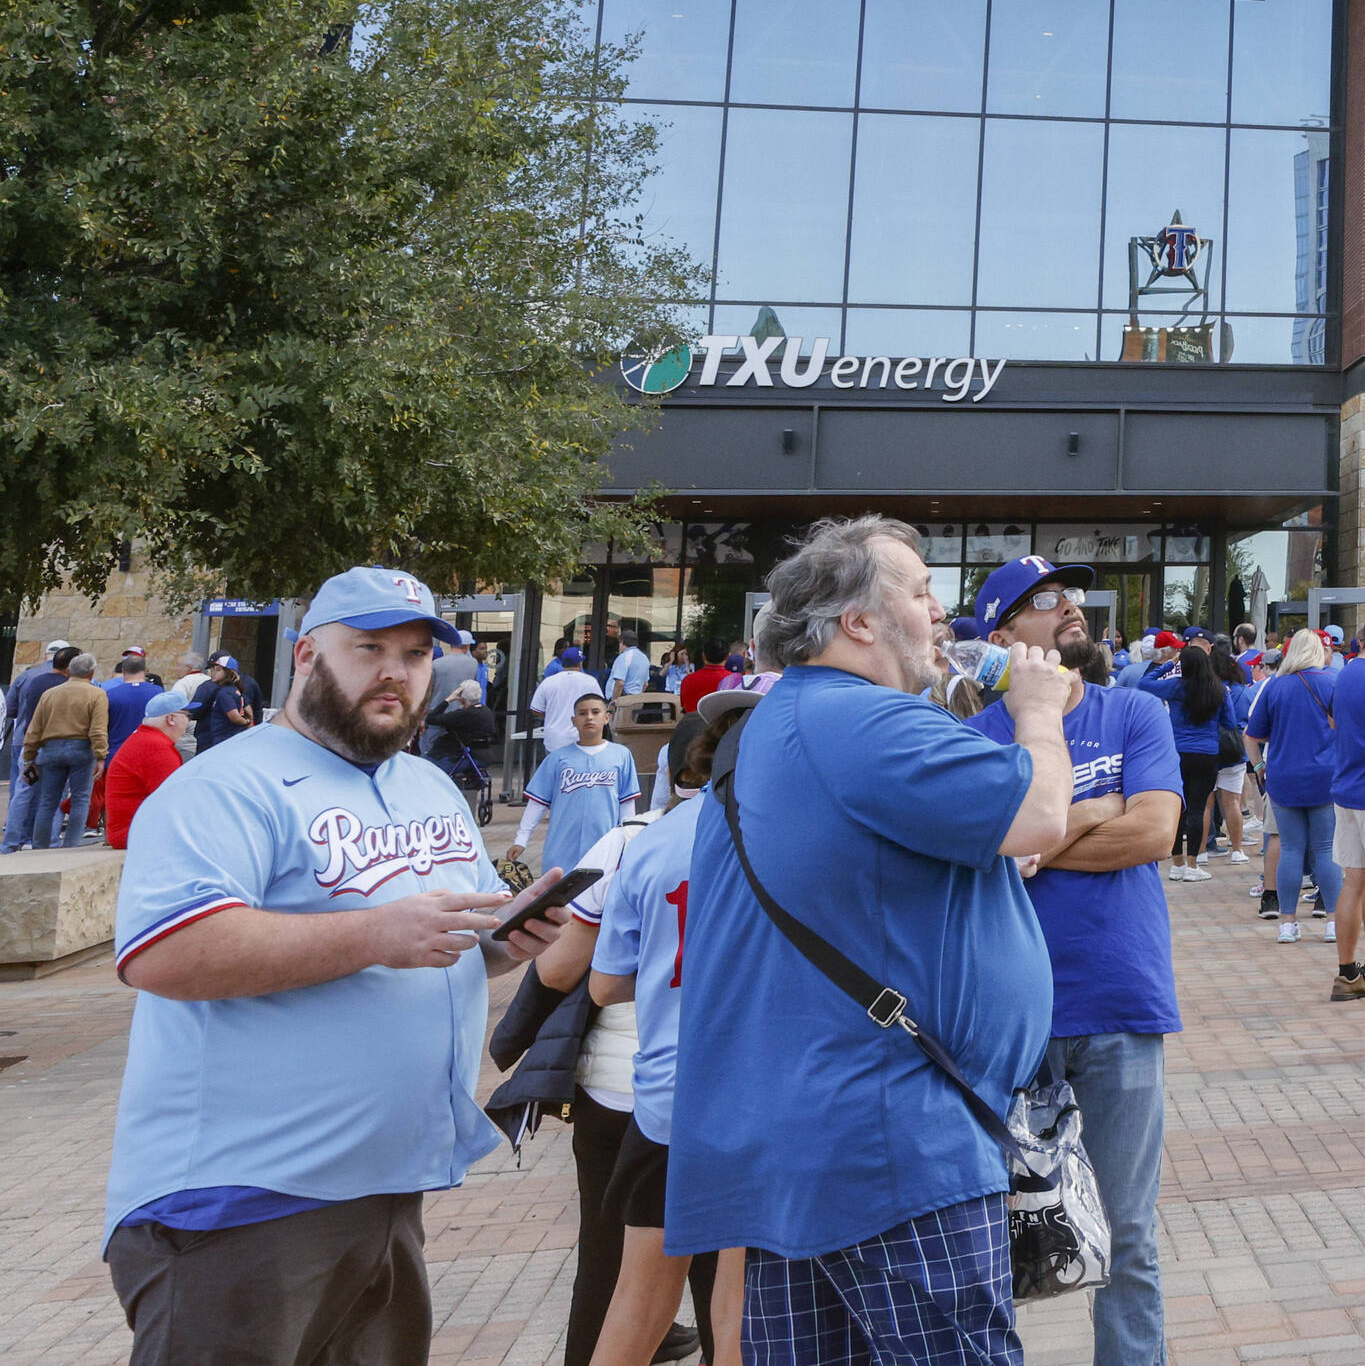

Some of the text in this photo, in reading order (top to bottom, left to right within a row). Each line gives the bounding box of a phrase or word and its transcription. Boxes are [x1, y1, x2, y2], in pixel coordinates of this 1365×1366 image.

[698, 334, 1007, 403] TXU energy
[1020, 555, 1050, 576] T
[391, 576, 423, 604] T
[1080, 739, 1100, 749] FOR
[560, 767, 619, 792] Rangers
[309, 807, 475, 887] Rangers
